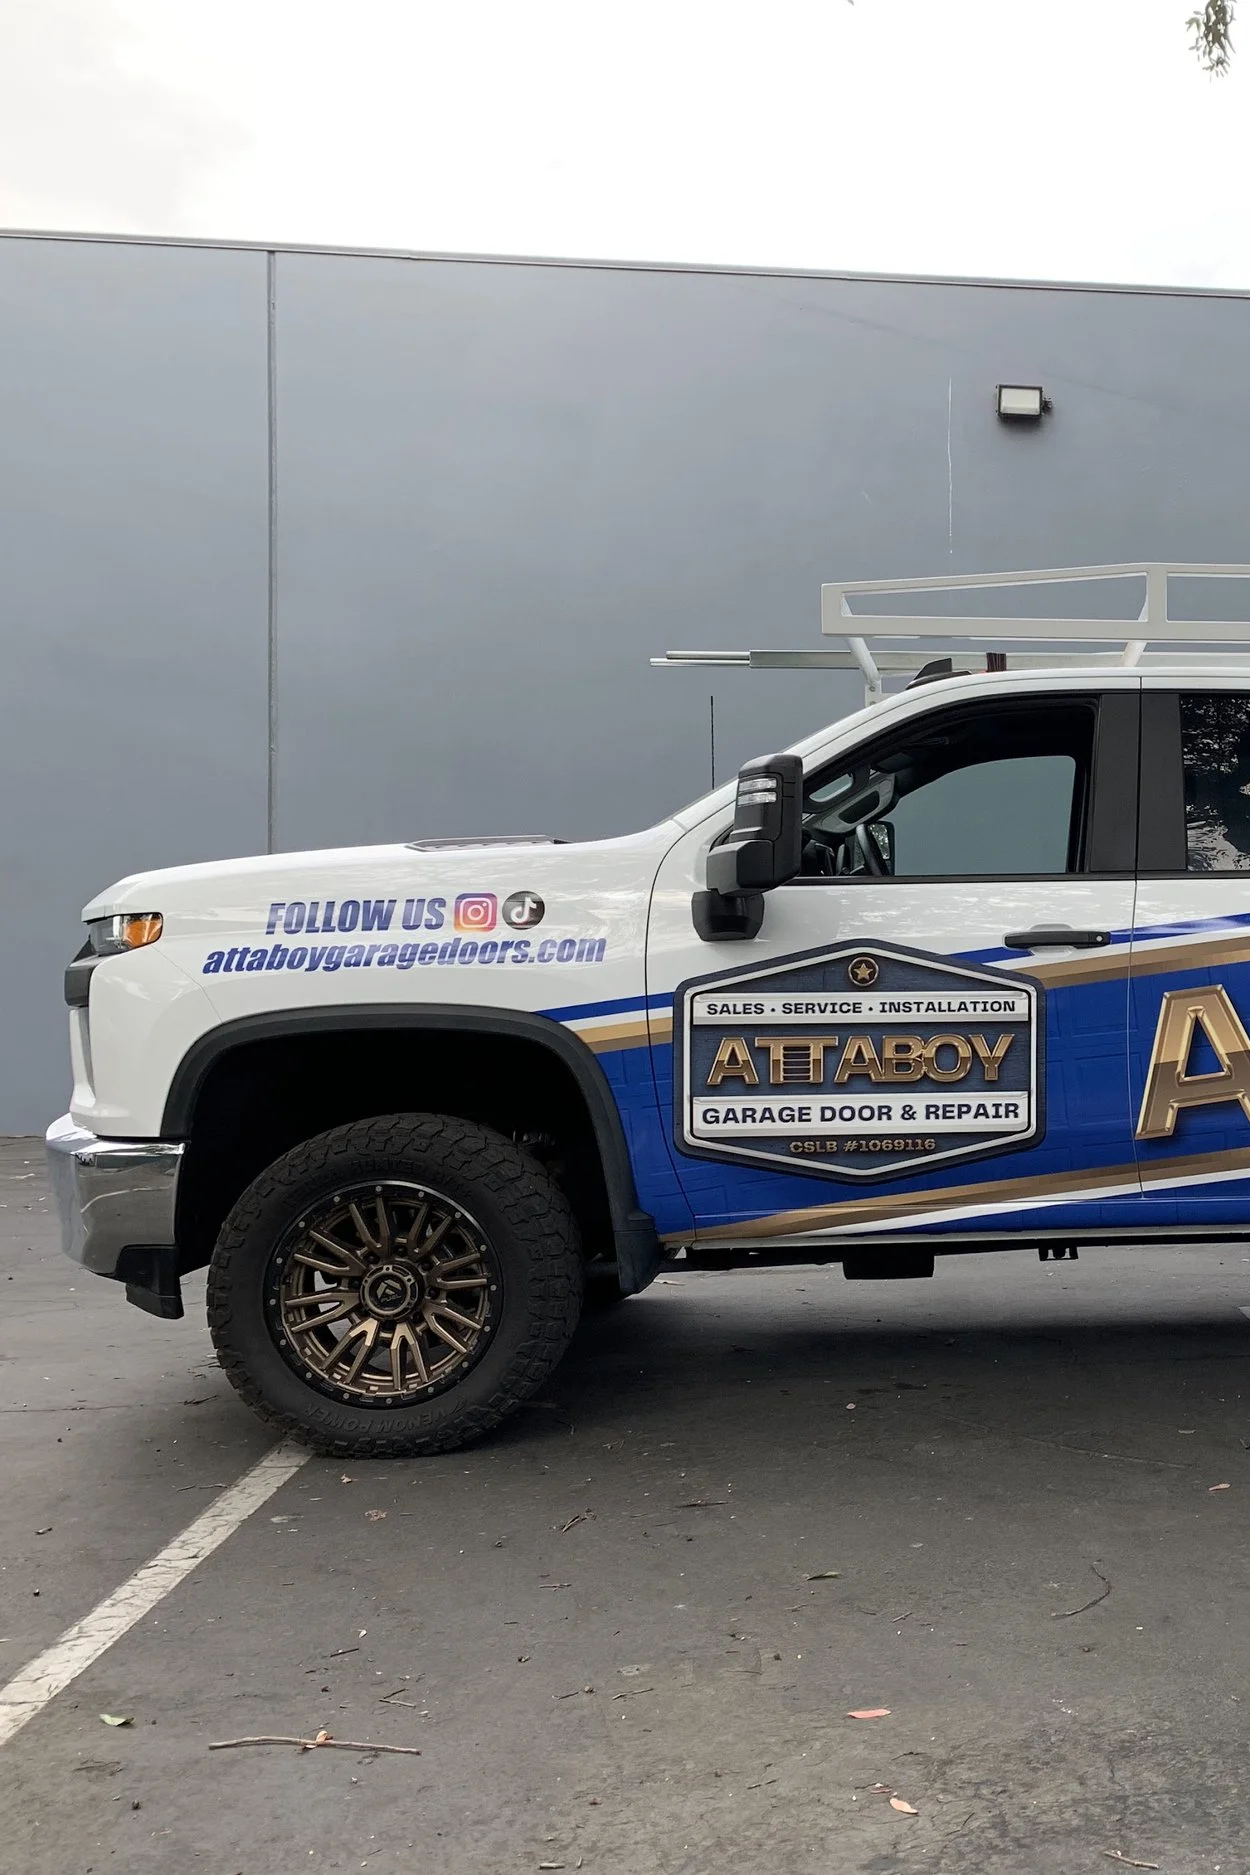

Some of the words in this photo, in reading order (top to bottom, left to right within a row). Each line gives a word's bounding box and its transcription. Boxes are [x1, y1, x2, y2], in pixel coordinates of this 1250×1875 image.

[265, 898, 396, 936] FOLLOW
[401, 897, 447, 931] US
[202, 937, 608, 975] attaboygaragedoors.com
[706, 1003, 765, 1015] SALES
[781, 1002, 863, 1014] SERVICE
[879, 1000, 1017, 1013] INSTALLATION
[706, 1034, 1016, 1085] ATTABOY
[702, 1107, 812, 1125] GARAGE
[819, 1105, 893, 1123] DOOR
[901, 1104, 917, 1121] &
[925, 1103, 1020, 1120] REPAIR
[790, 1141, 837, 1153] CSLB
[842, 1138, 936, 1152] #1069116
